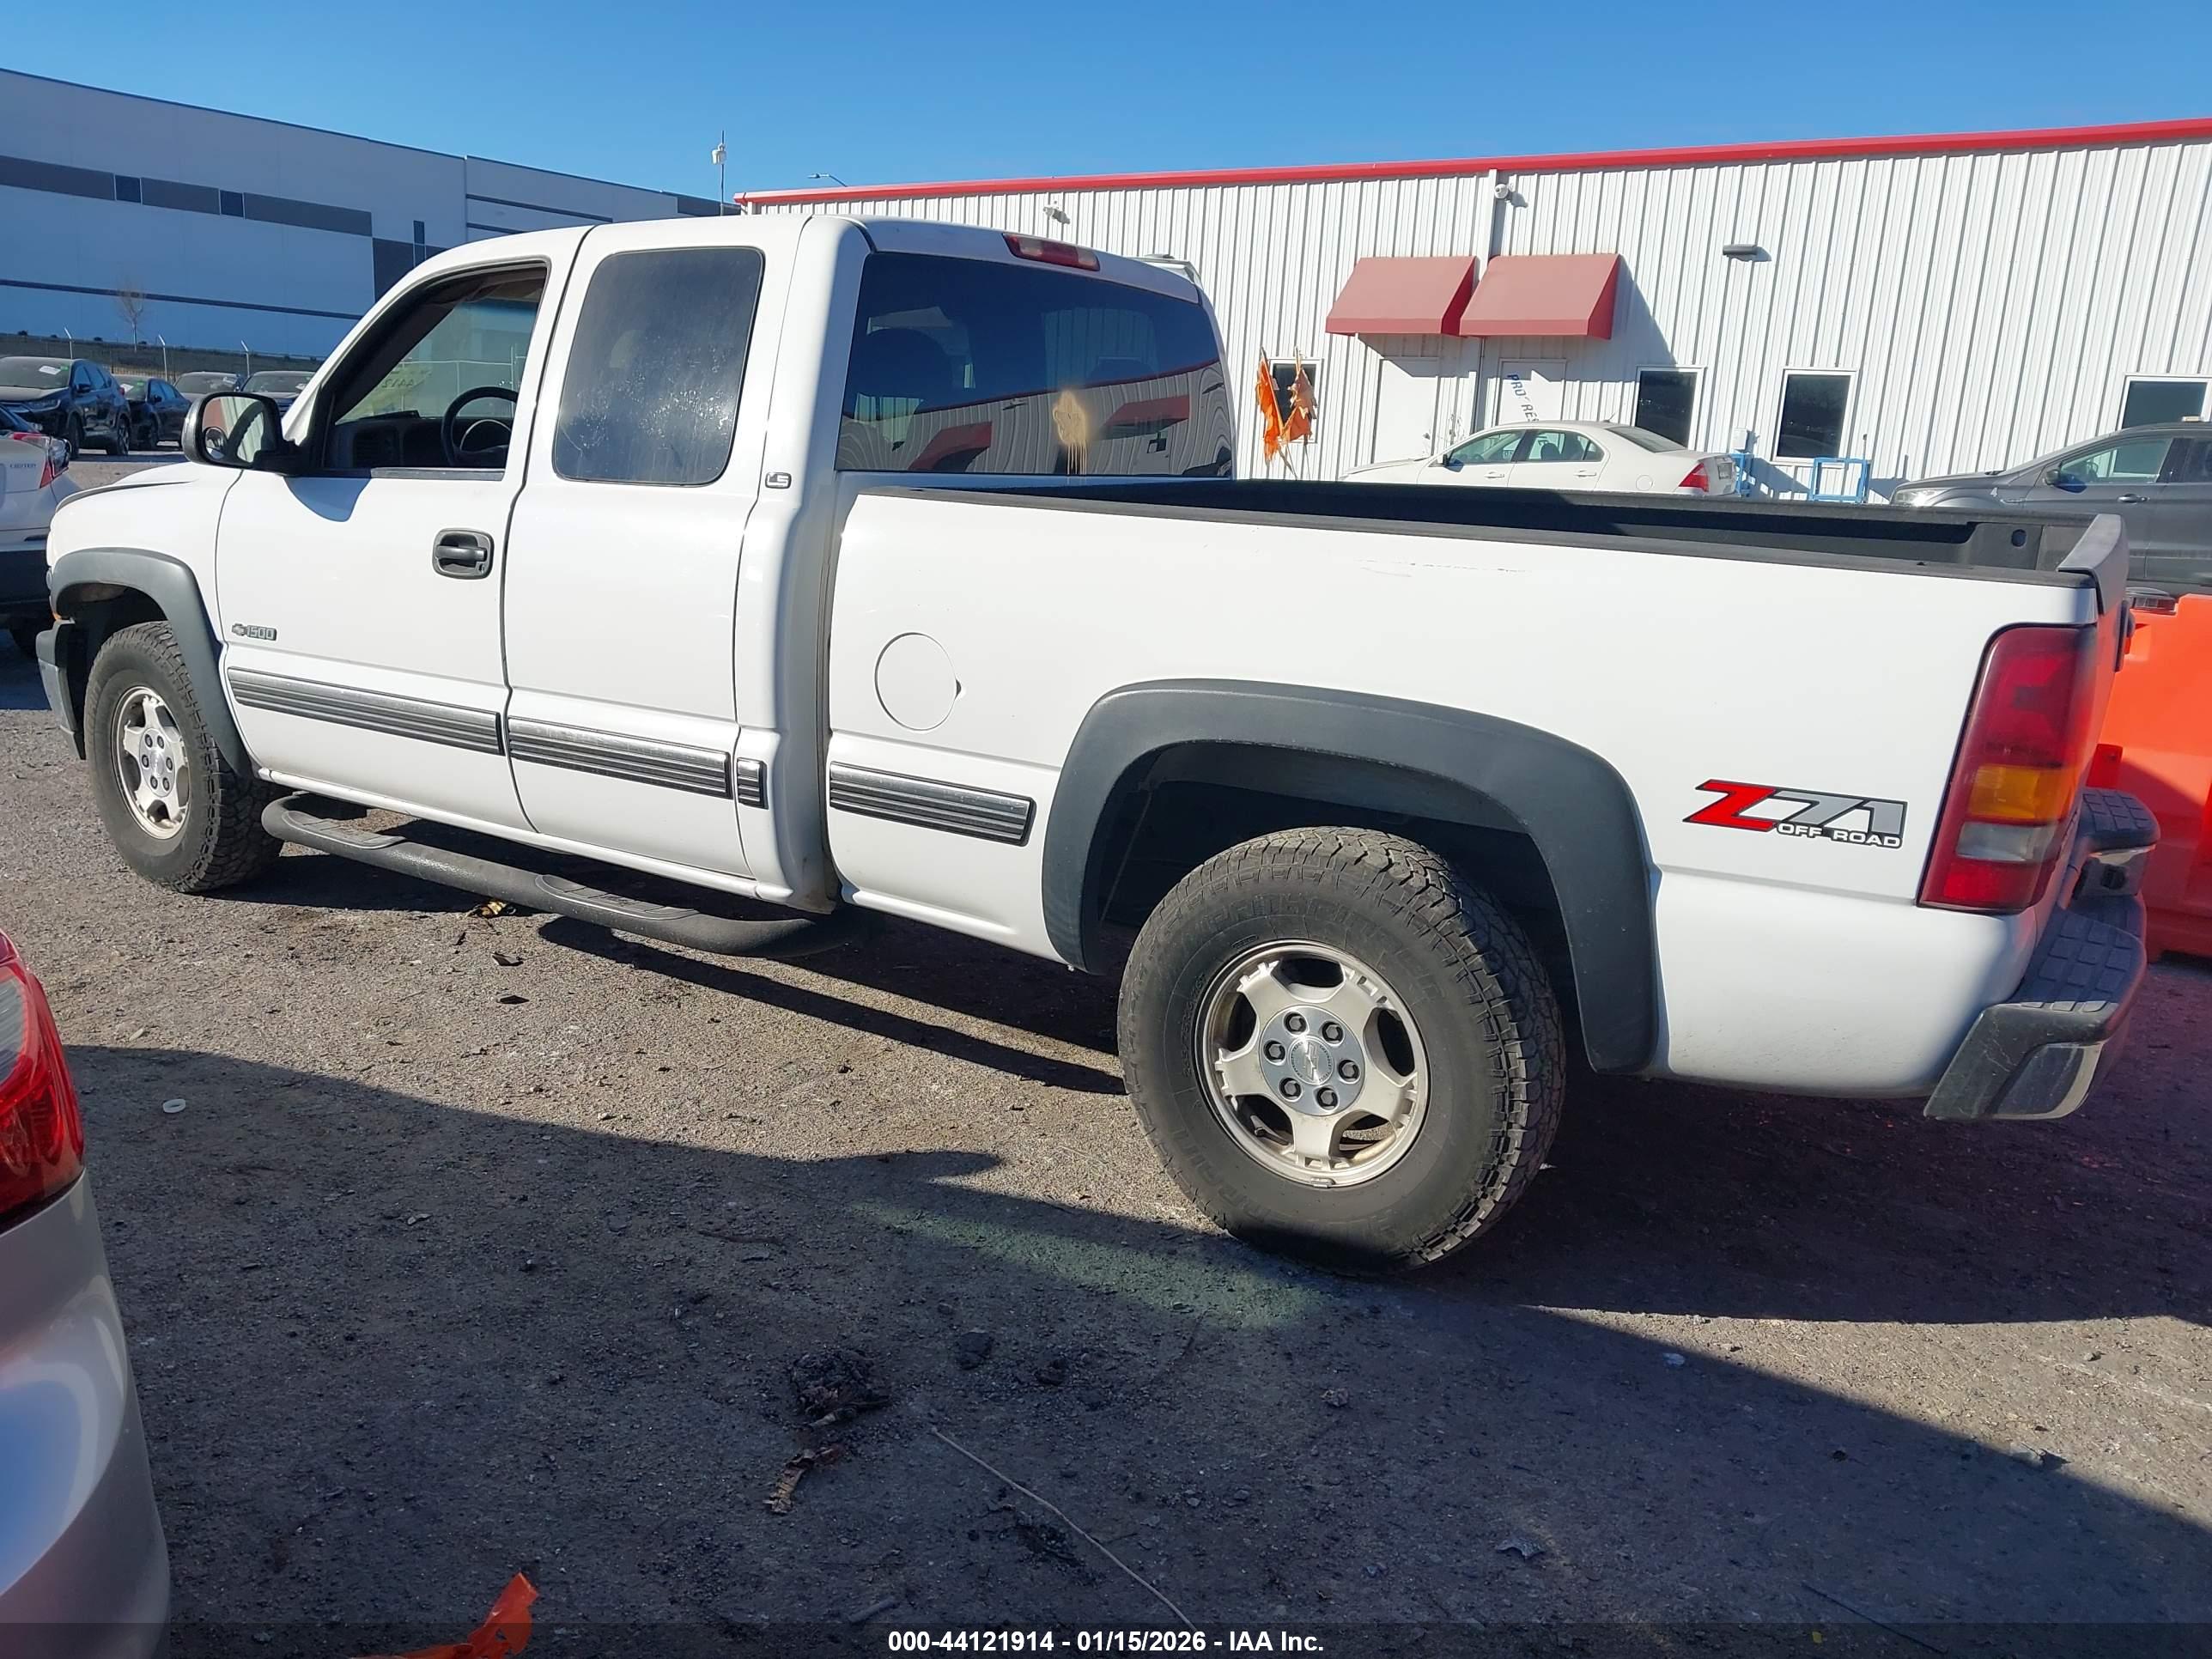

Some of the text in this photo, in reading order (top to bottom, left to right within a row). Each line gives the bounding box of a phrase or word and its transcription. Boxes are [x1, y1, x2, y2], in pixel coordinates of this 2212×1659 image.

[246, 625, 276, 640] 1500
[1681, 778, 1908, 842] Z71
[1778, 822, 1900, 848] OFF ROAD
